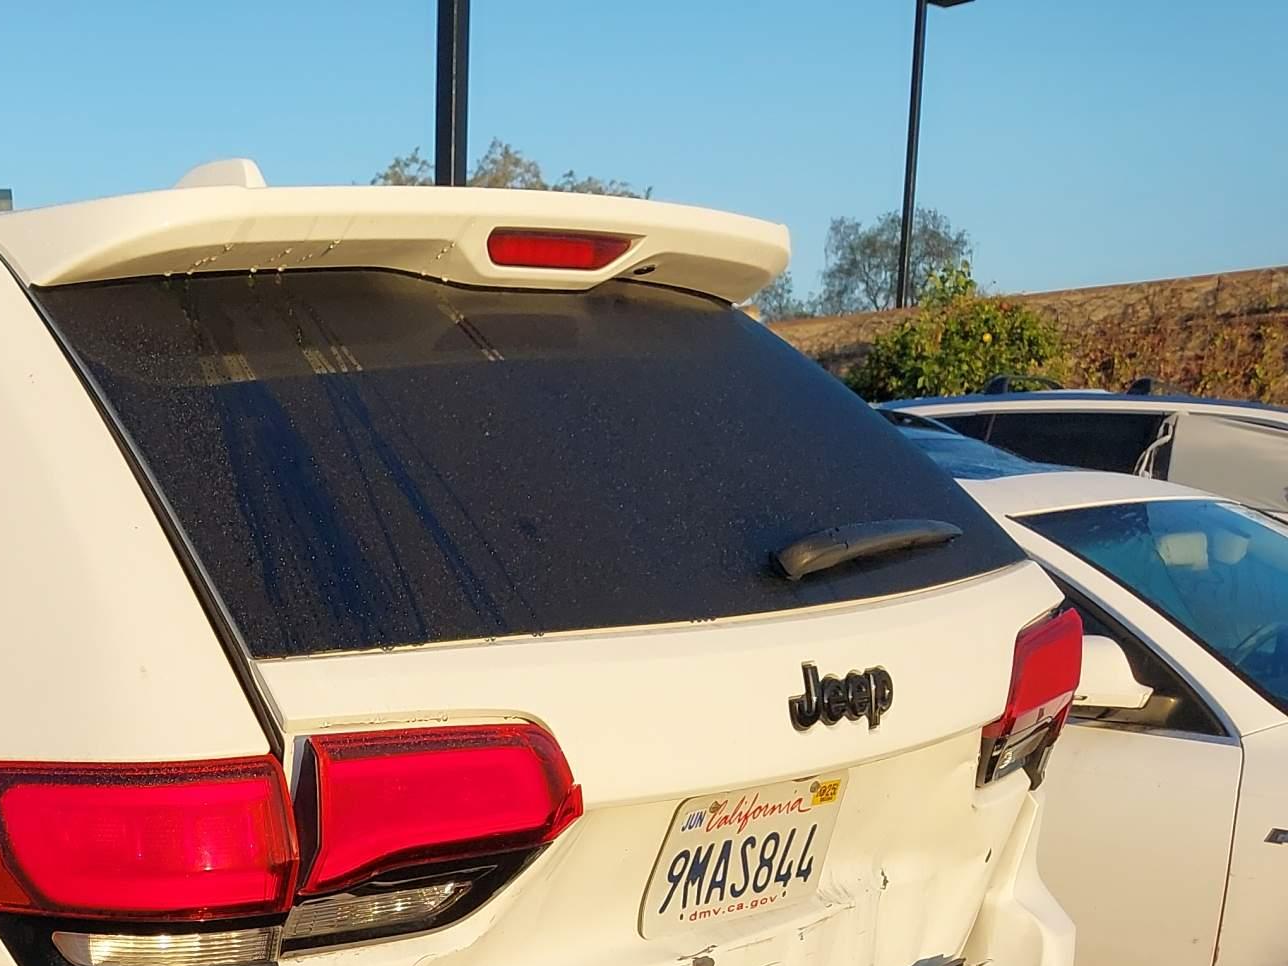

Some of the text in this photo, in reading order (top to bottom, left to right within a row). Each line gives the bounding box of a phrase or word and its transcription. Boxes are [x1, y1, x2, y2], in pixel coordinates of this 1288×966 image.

[788, 661, 893, 731] Jeep
[681, 792, 811, 834] JUN California
[659, 823, 818, 914] 9MAS844
[689, 895, 778, 921] dmv.ca.gov
